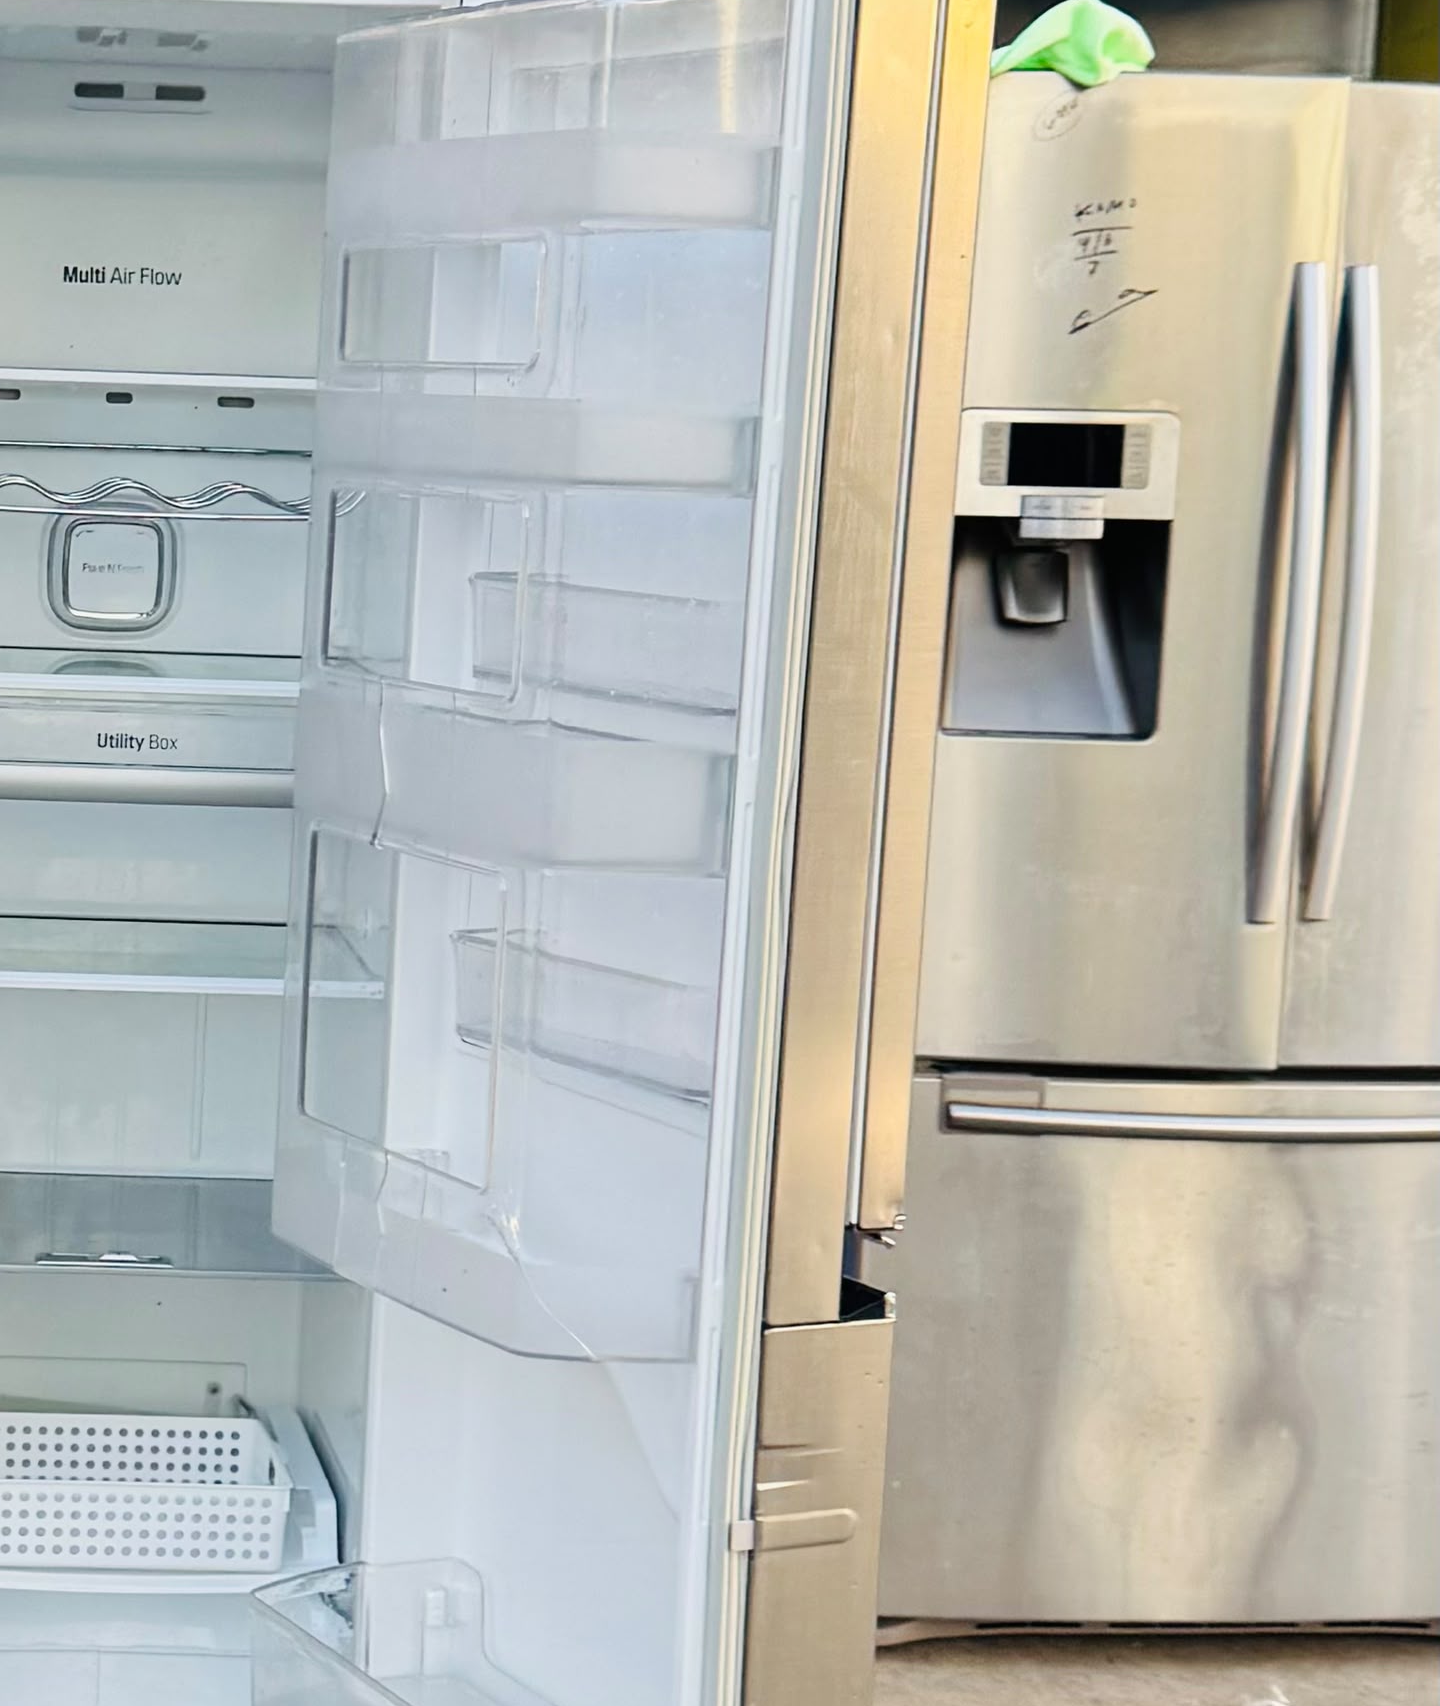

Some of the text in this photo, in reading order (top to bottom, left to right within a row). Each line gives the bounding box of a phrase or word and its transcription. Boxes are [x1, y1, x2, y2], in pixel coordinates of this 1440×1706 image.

[63, 265, 182, 286] Multi Air Flow
[97, 732, 178, 752] Utility Box
